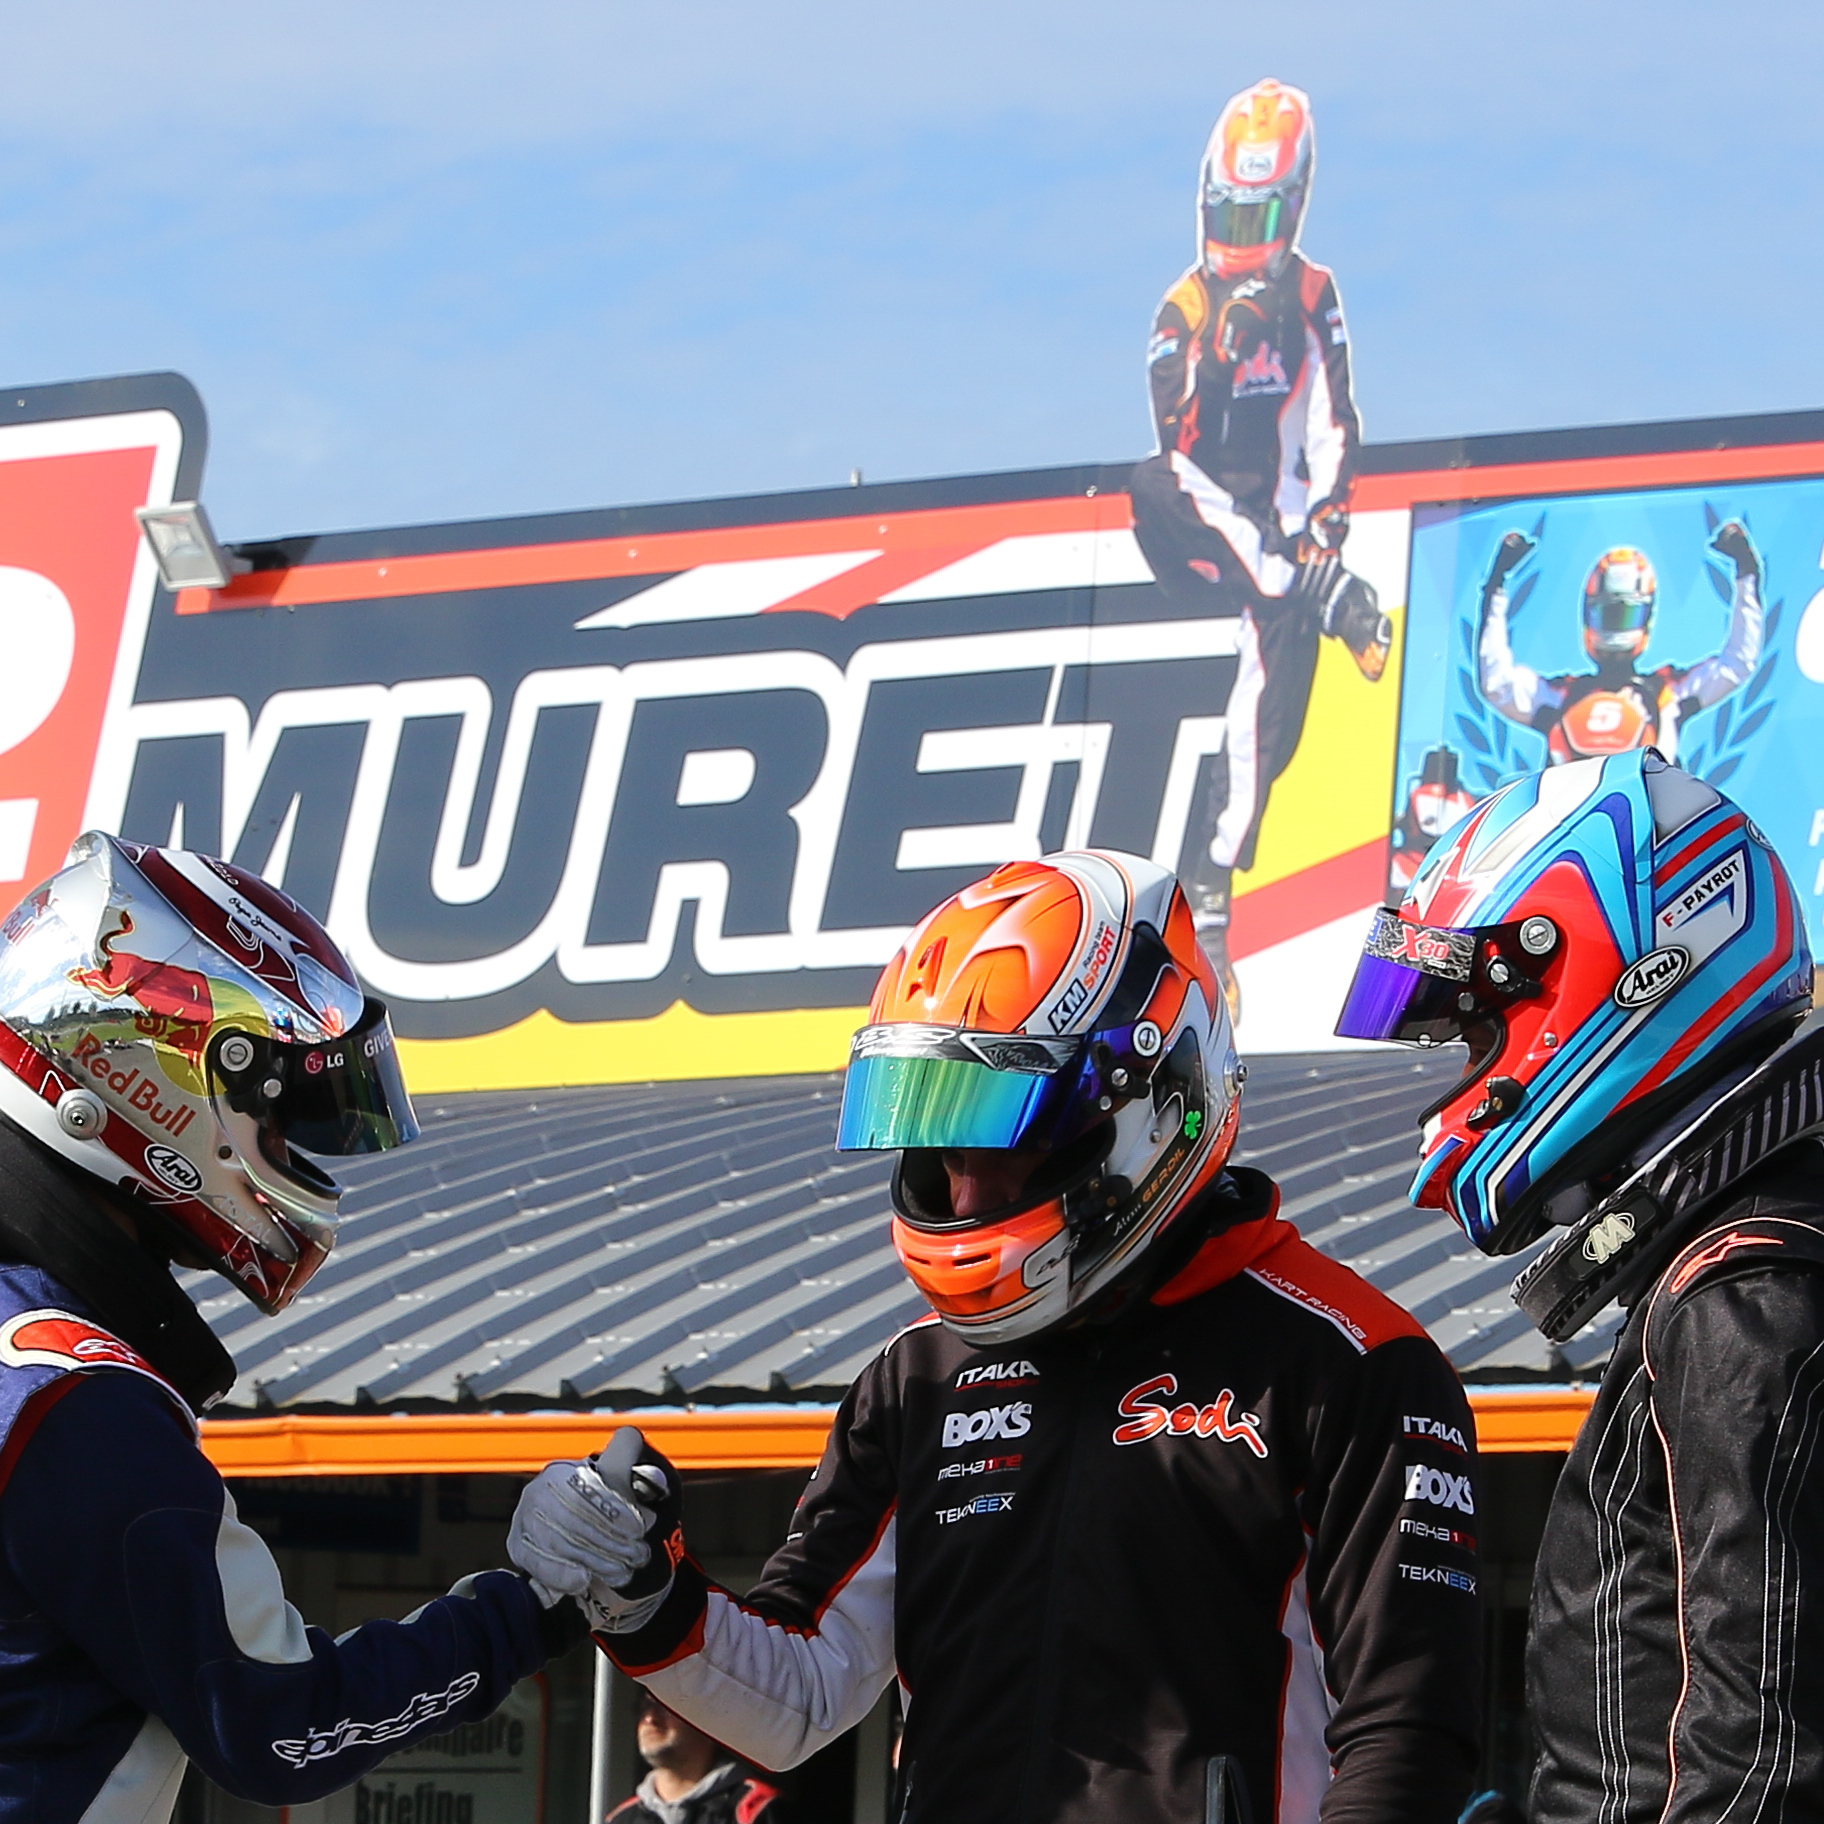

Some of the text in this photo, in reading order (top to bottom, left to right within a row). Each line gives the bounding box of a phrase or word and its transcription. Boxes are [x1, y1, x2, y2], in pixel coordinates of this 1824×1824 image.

[118, 654, 1240, 963] MURET
[1082, 925, 1116, 991] SPORT
[1392, 924, 1450, 961] X30
[1625, 950, 1679, 1004] Arai
[1050, 983, 1086, 1032] KM
[72, 1032, 197, 1138] Red Bull
[326, 1053, 345, 1069] LG
[1258, 1267, 1367, 1340] KART RACING
[955, 1360, 1040, 1389] ITAKA
[1112, 1373, 1269, 1459] Sodi
[1403, 1415, 1469, 1453] ITAKA
[1398, 1563, 1476, 1596] TEKNEEX
